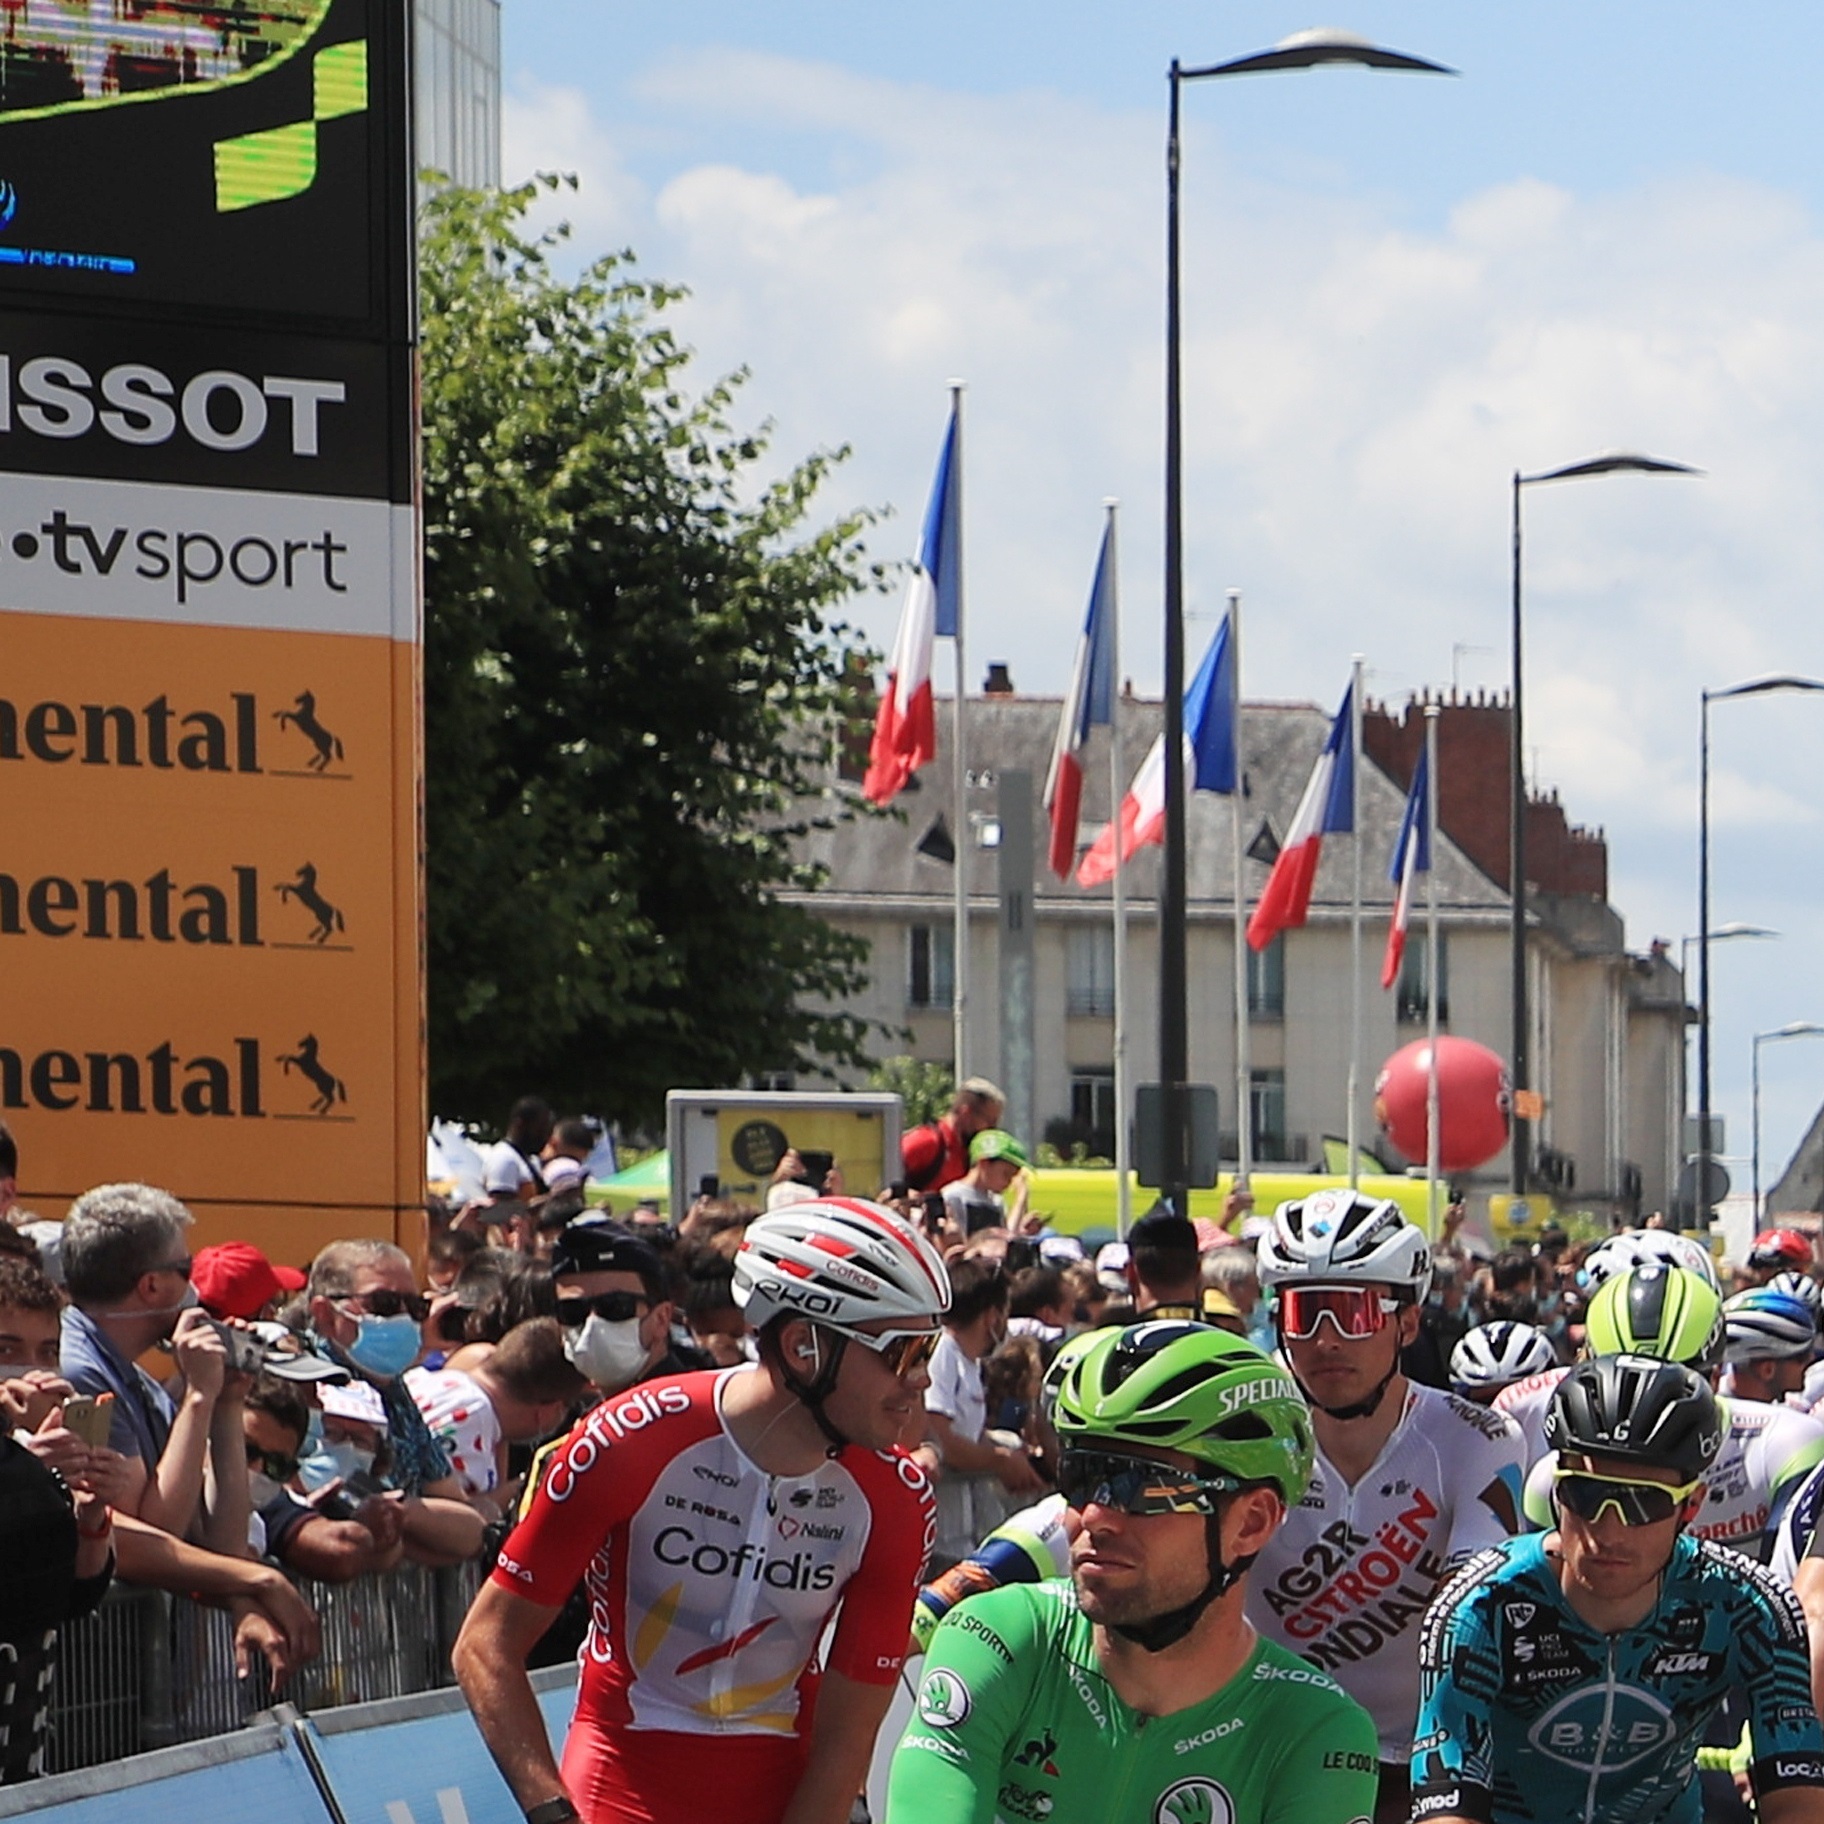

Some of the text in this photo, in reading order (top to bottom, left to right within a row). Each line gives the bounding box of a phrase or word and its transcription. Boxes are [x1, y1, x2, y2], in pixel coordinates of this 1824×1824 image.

[546, 1383, 691, 1502] Cofidis
[690, 1502, 741, 1526] ROSA
[652, 1526, 836, 1591] Cofidis
[1262, 1519, 1370, 1613] AG2R
